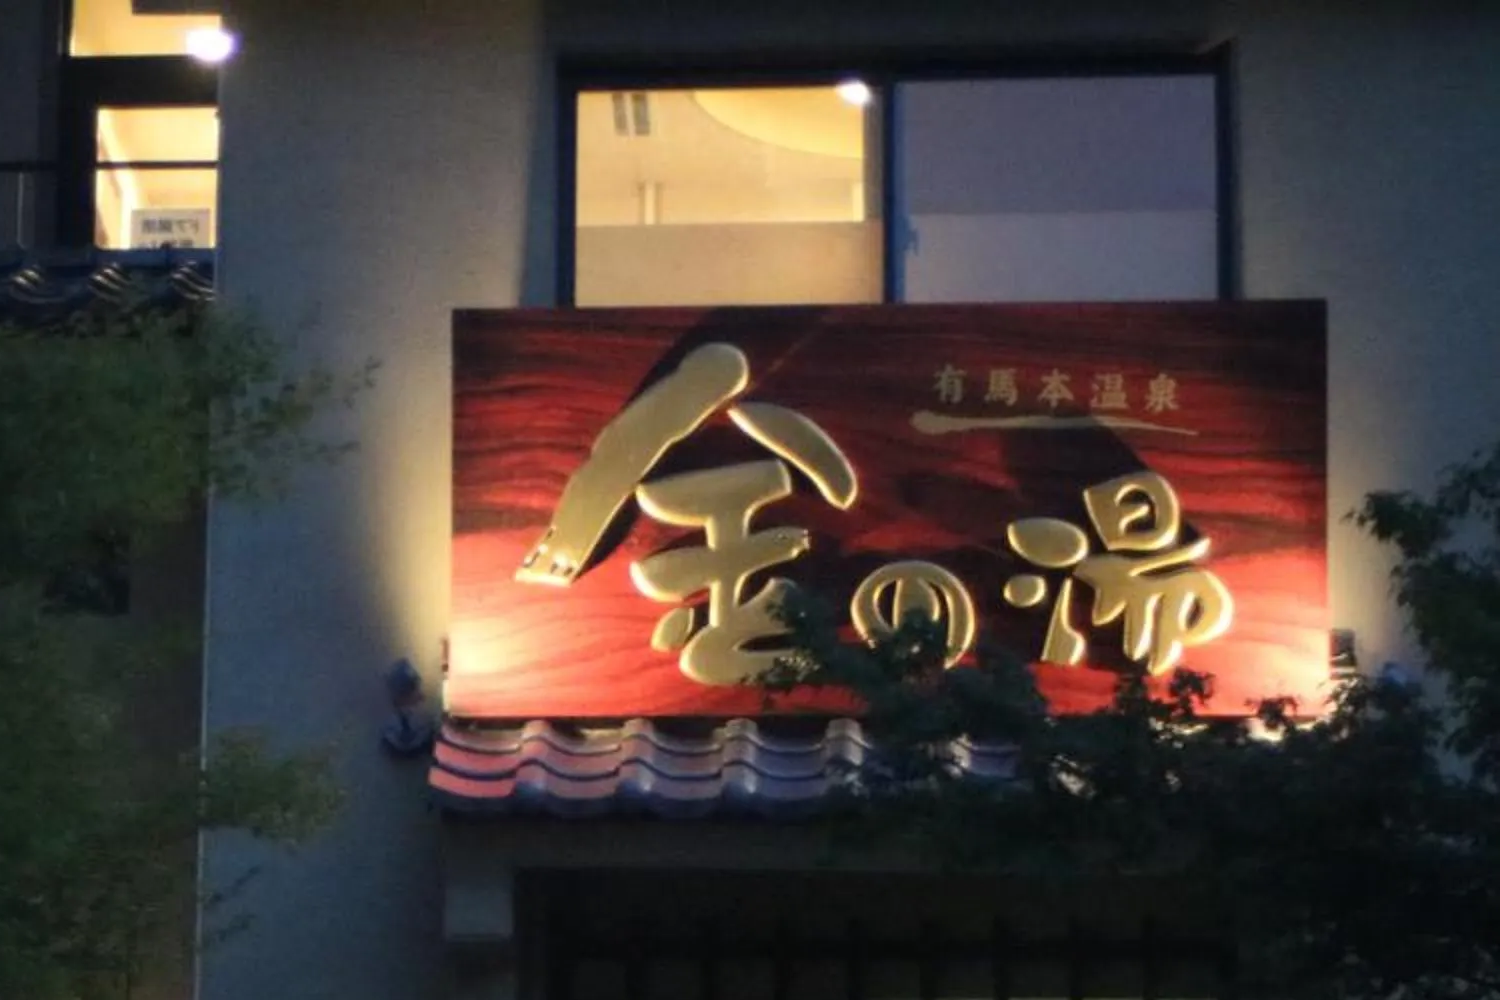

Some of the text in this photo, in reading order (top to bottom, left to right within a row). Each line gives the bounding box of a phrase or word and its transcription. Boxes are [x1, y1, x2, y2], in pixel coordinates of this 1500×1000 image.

[931, 364, 1184, 414] 有馬本温泉
[512, 341, 1235, 686] 金の湯
